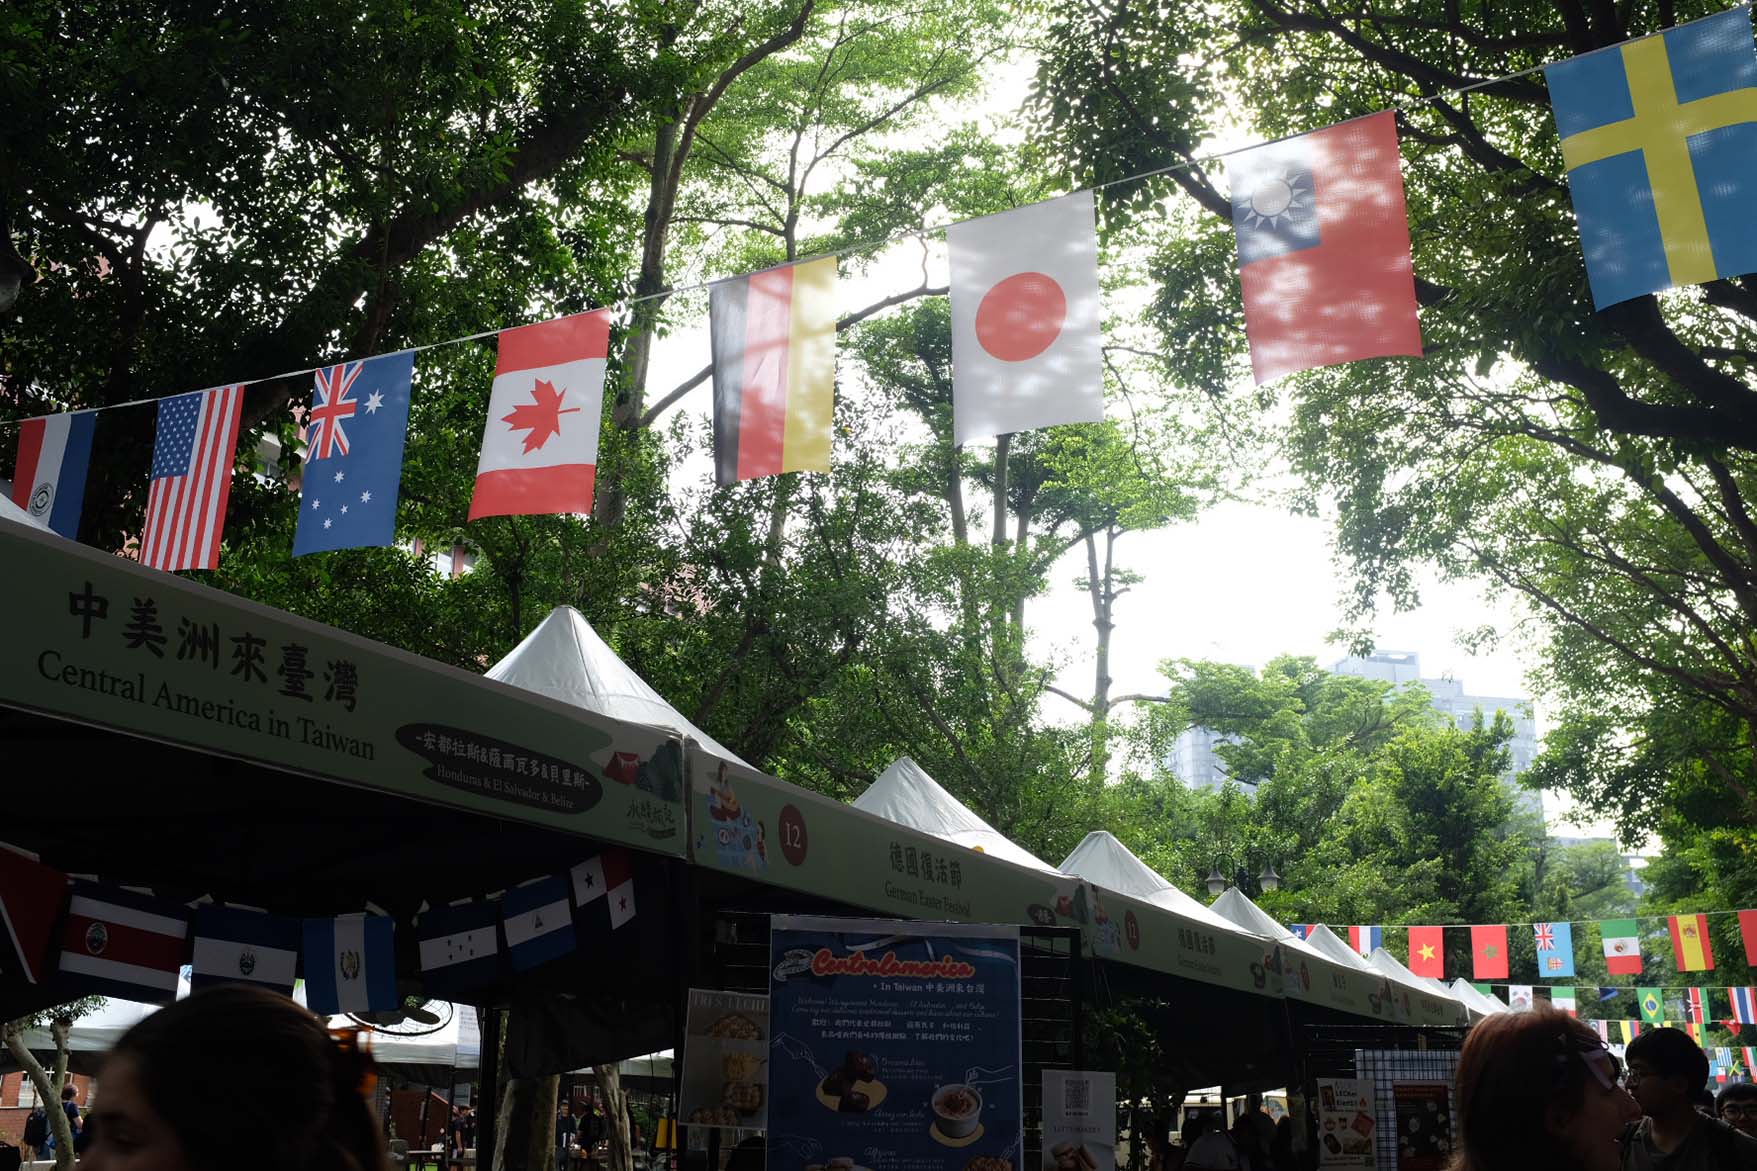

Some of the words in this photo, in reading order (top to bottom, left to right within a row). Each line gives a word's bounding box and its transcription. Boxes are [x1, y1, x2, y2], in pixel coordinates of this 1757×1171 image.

[69, 581, 358, 713] 中美洲來臺灣
[38, 650, 145, 704] Central
[152, 681, 261, 733] America
[269, 709, 291, 740] in
[297, 717, 376, 761] Taiwan
[437, 764, 482, 786] Honduras
[483, 777, 492, 790] &
[493, 778, 503, 792] El
[504, 782, 541, 801] Salvador
[784, 821, 801, 849] 12
[889, 841, 962, 890] 德國復活節
[884, 880, 917, 905] German
[811, 948, 976, 980] Centralamerica
[880, 982, 891, 991] In
[893, 982, 923, 992] Taiwan
